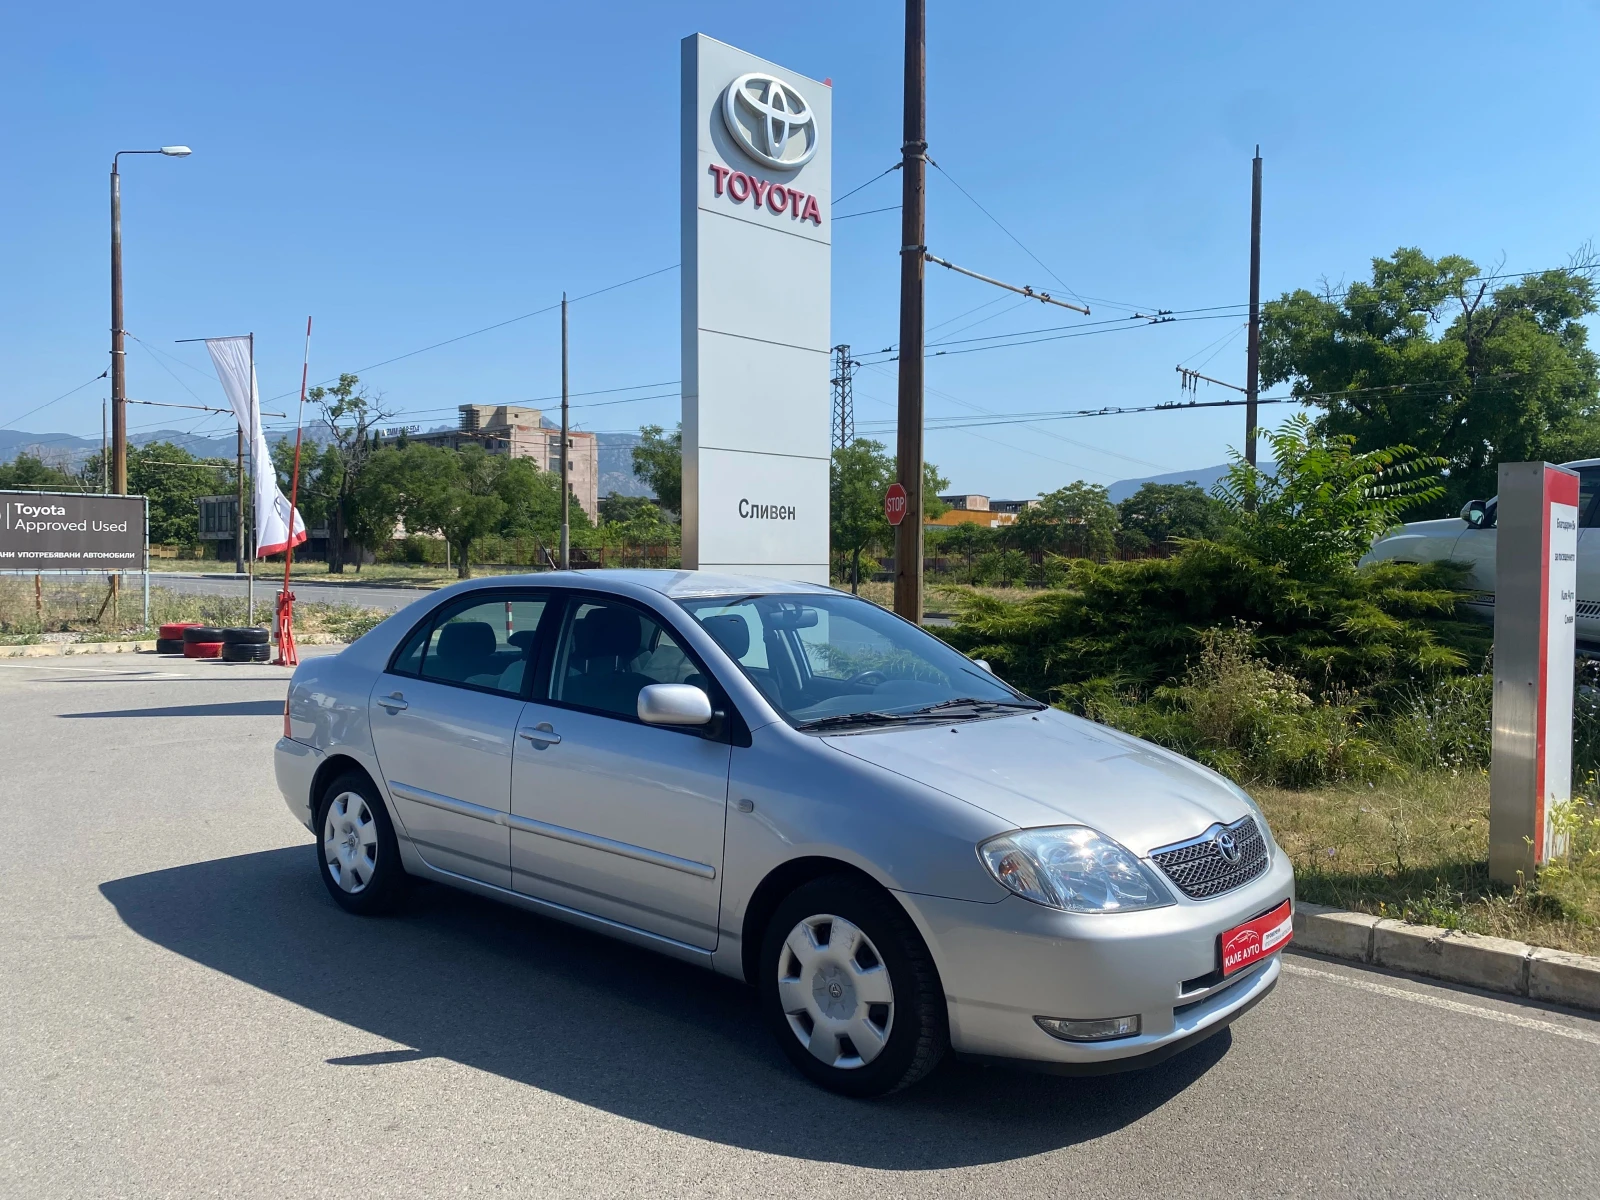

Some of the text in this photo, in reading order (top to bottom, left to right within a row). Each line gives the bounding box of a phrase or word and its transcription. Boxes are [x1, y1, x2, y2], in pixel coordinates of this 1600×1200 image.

[709, 164, 821, 224] TOYOTA
[14, 503, 66, 517] Toyota
[738, 498, 796, 520] Сливен
[887, 496, 905, 512] STOP
[14, 518, 127, 533] Approved Used
[17, 551, 81, 559] УПОТРЕБЯВАНИ
[1225, 943, 1260, 968] КАЛЕ АУТО
